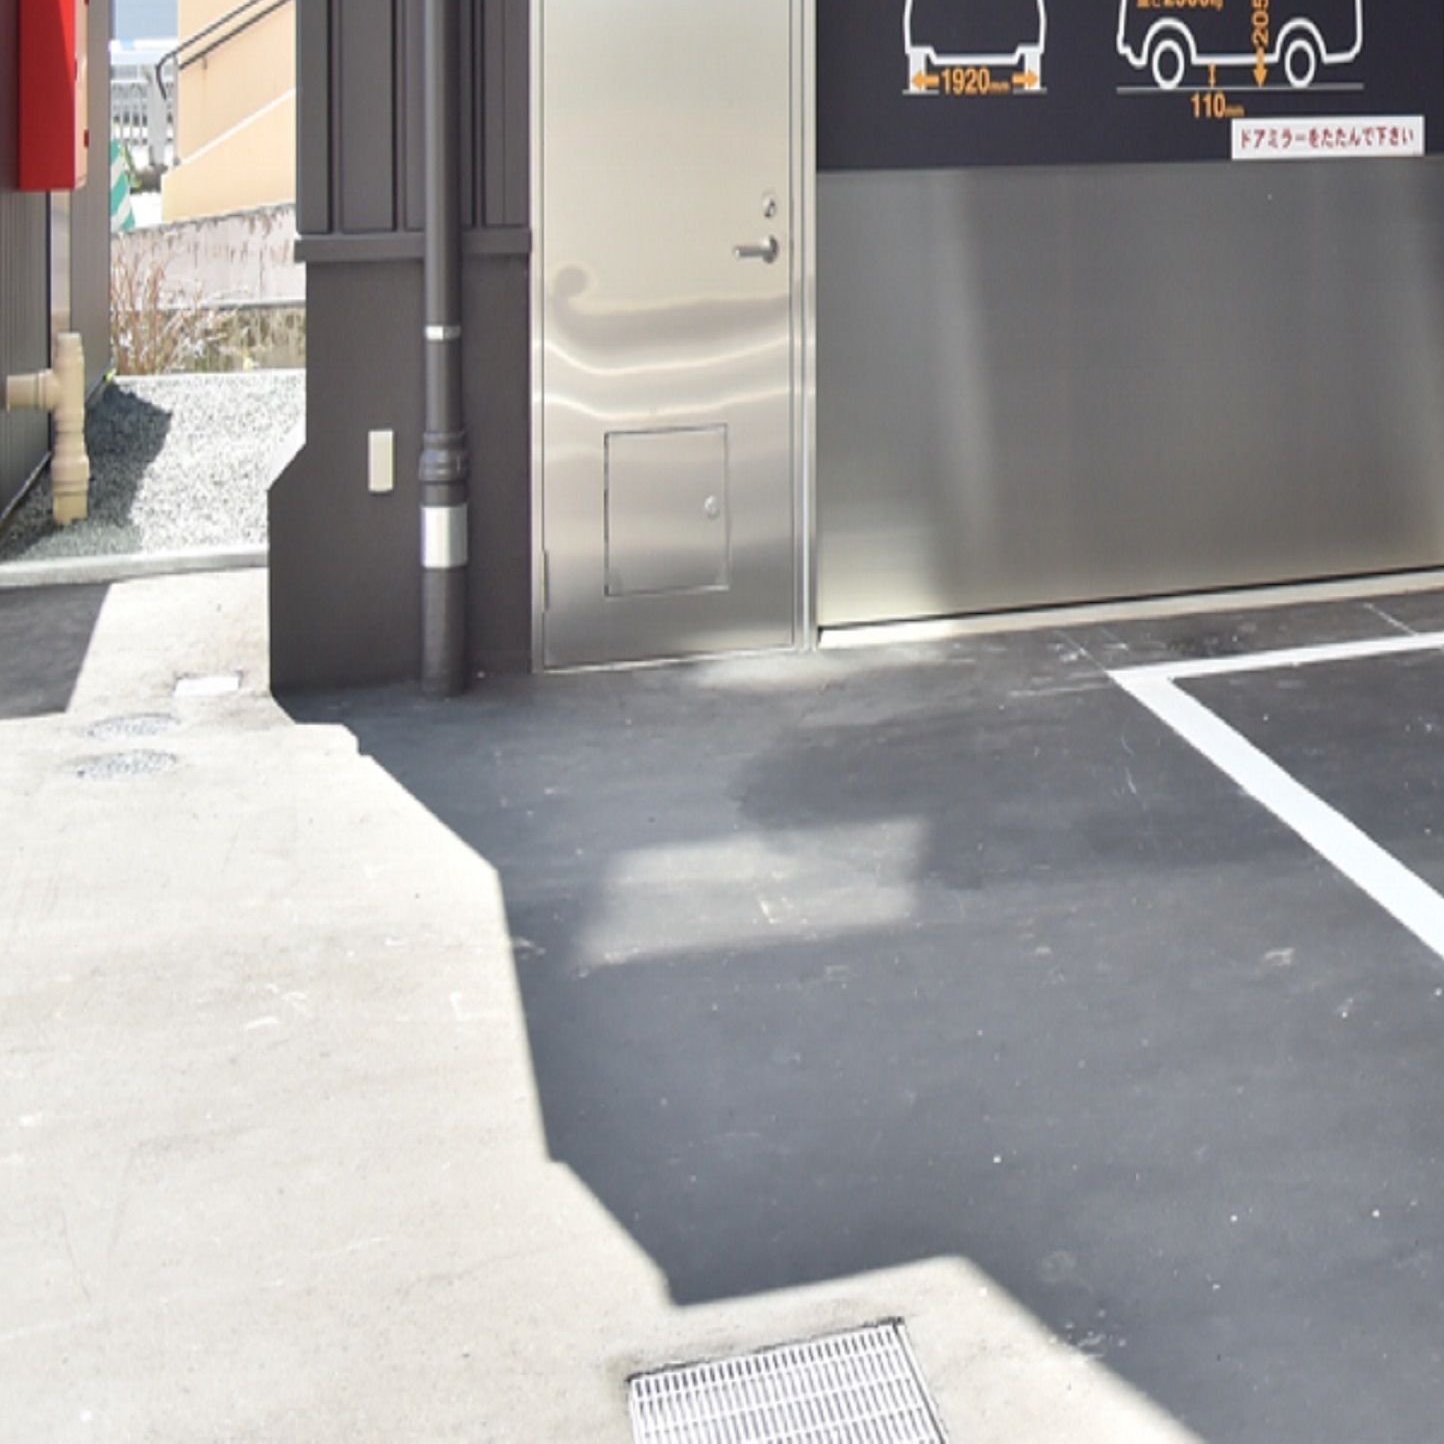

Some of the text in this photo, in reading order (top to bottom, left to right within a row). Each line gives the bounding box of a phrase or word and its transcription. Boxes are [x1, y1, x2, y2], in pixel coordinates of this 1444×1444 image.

[1240, 126, 1414, 149] ドアミラーをたたんで下さい
